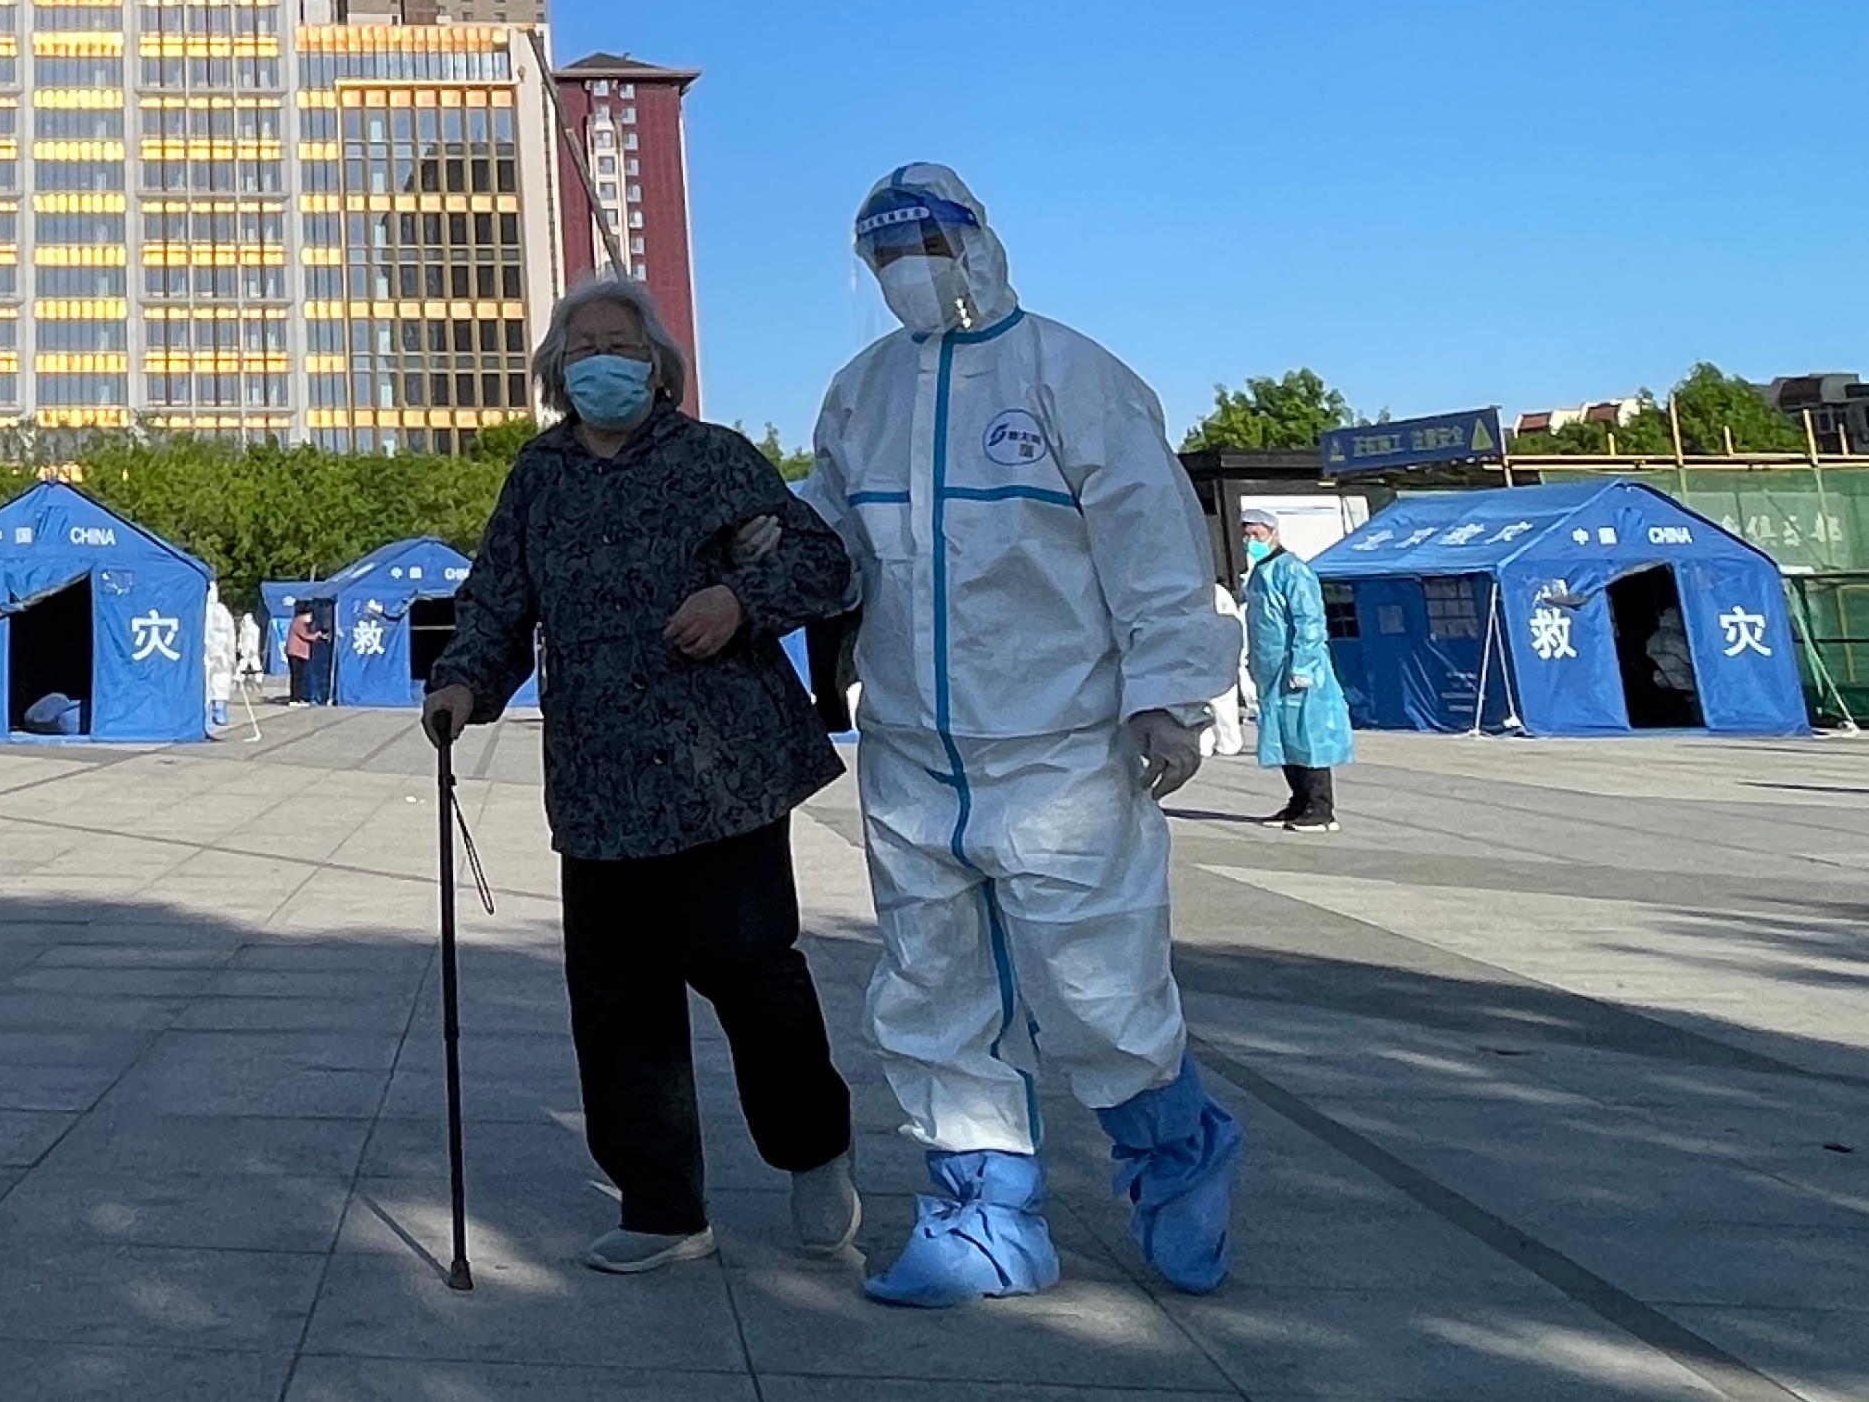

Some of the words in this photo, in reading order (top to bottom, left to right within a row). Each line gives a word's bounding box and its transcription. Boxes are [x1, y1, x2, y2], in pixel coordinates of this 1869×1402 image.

[70, 527, 115, 546] CHINA
[1572, 526, 1618, 546] 中国
[1648, 526, 1693, 545] CHINA
[131, 609, 181, 662] 灾
[353, 620, 386, 655] 救
[1529, 607, 1577, 660] 救
[1719, 605, 1772, 657] 灾
